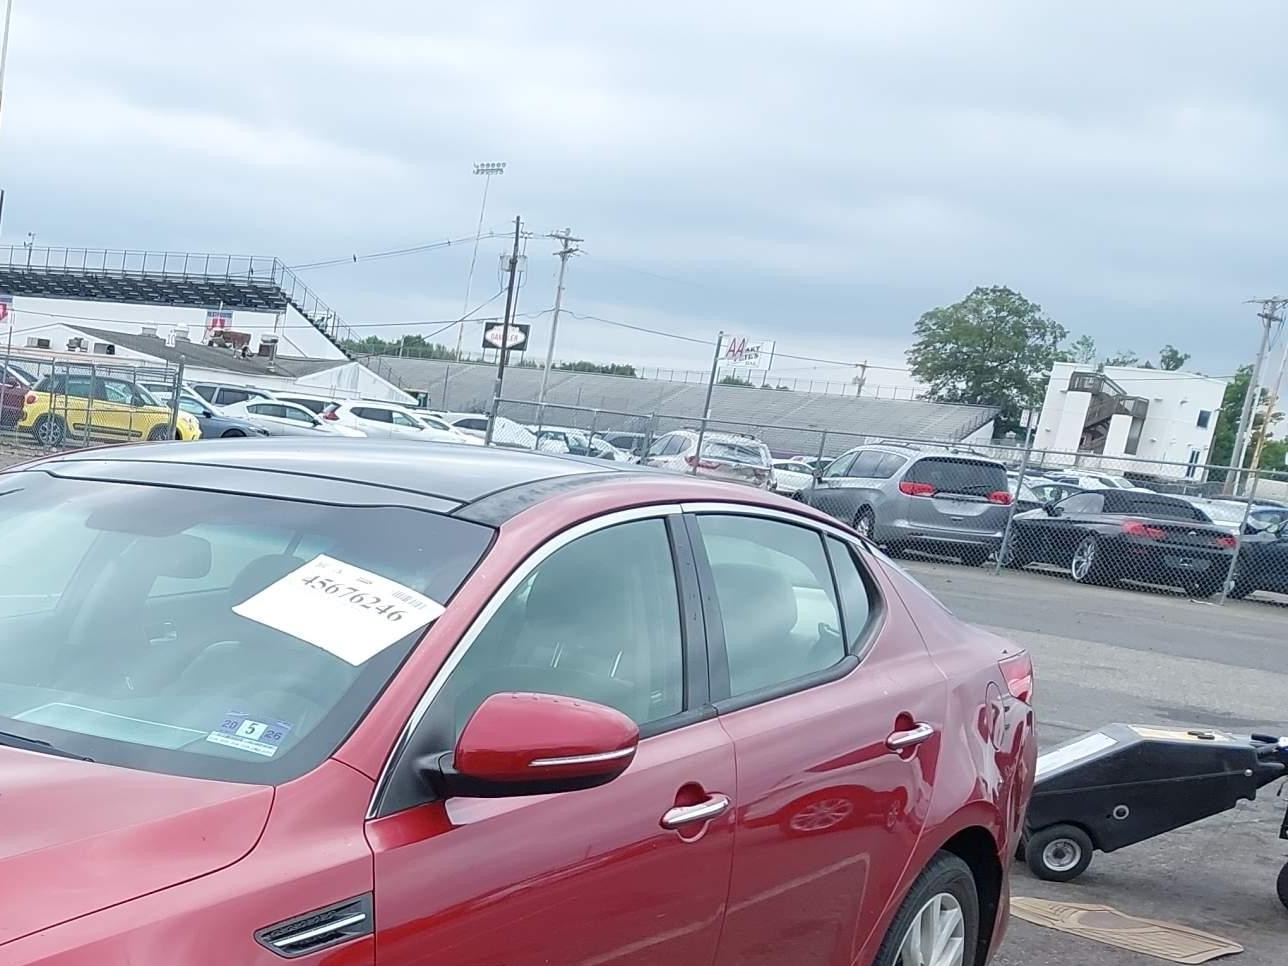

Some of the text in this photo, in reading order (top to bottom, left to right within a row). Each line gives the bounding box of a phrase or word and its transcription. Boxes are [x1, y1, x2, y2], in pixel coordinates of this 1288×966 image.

[301, 575, 409, 622] 45676246
[222, 719, 283, 741] 20 5 26
